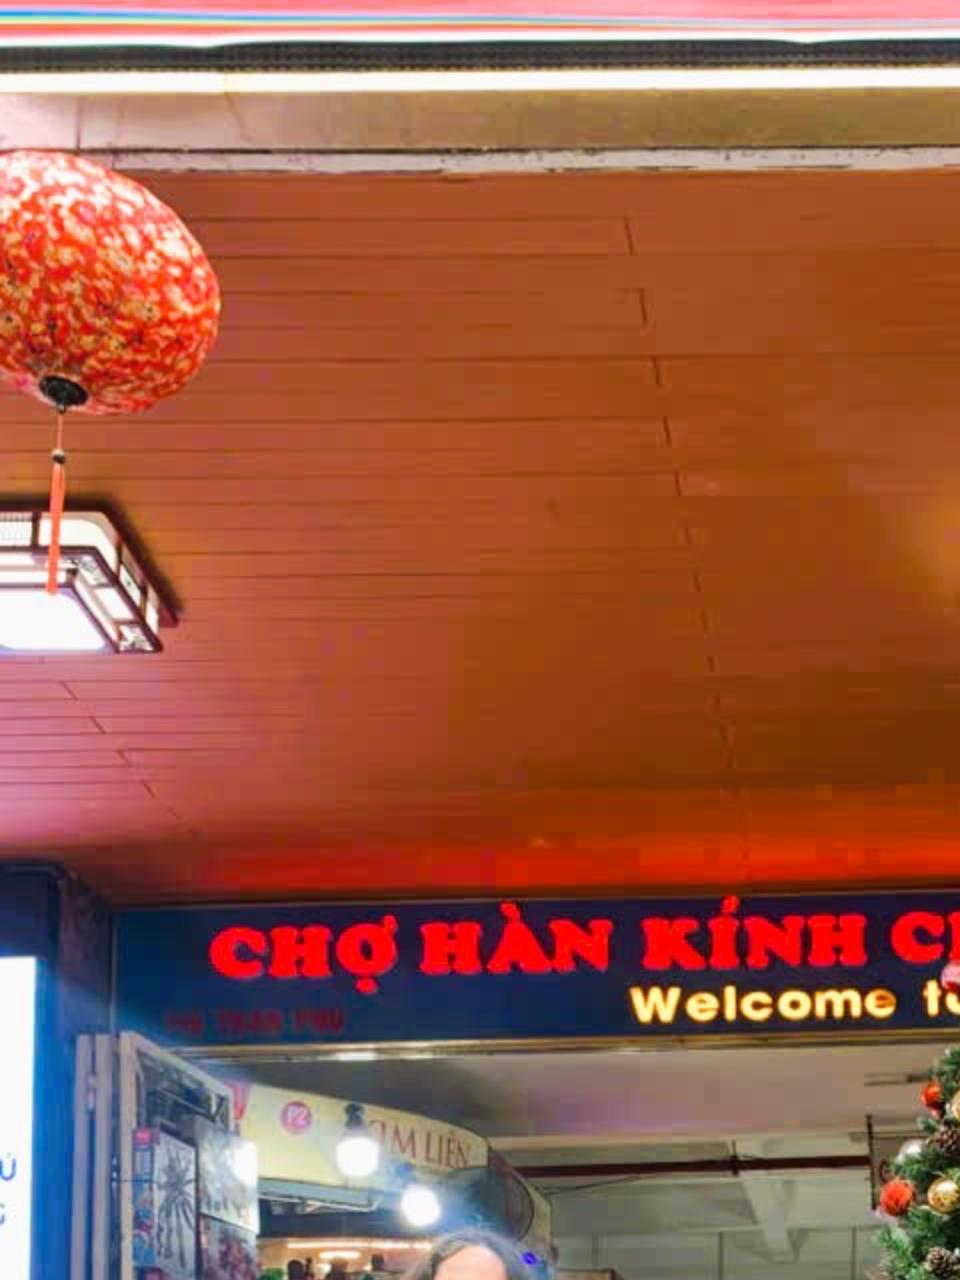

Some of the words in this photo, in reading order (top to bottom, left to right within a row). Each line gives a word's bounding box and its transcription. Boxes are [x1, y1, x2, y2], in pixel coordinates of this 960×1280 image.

[209, 915, 397, 995] CHỢ
[418, 900, 611, 976] HÀN
[642, 895, 868, 970] KÍNH
[629, 985, 897, 1025] Welcome
